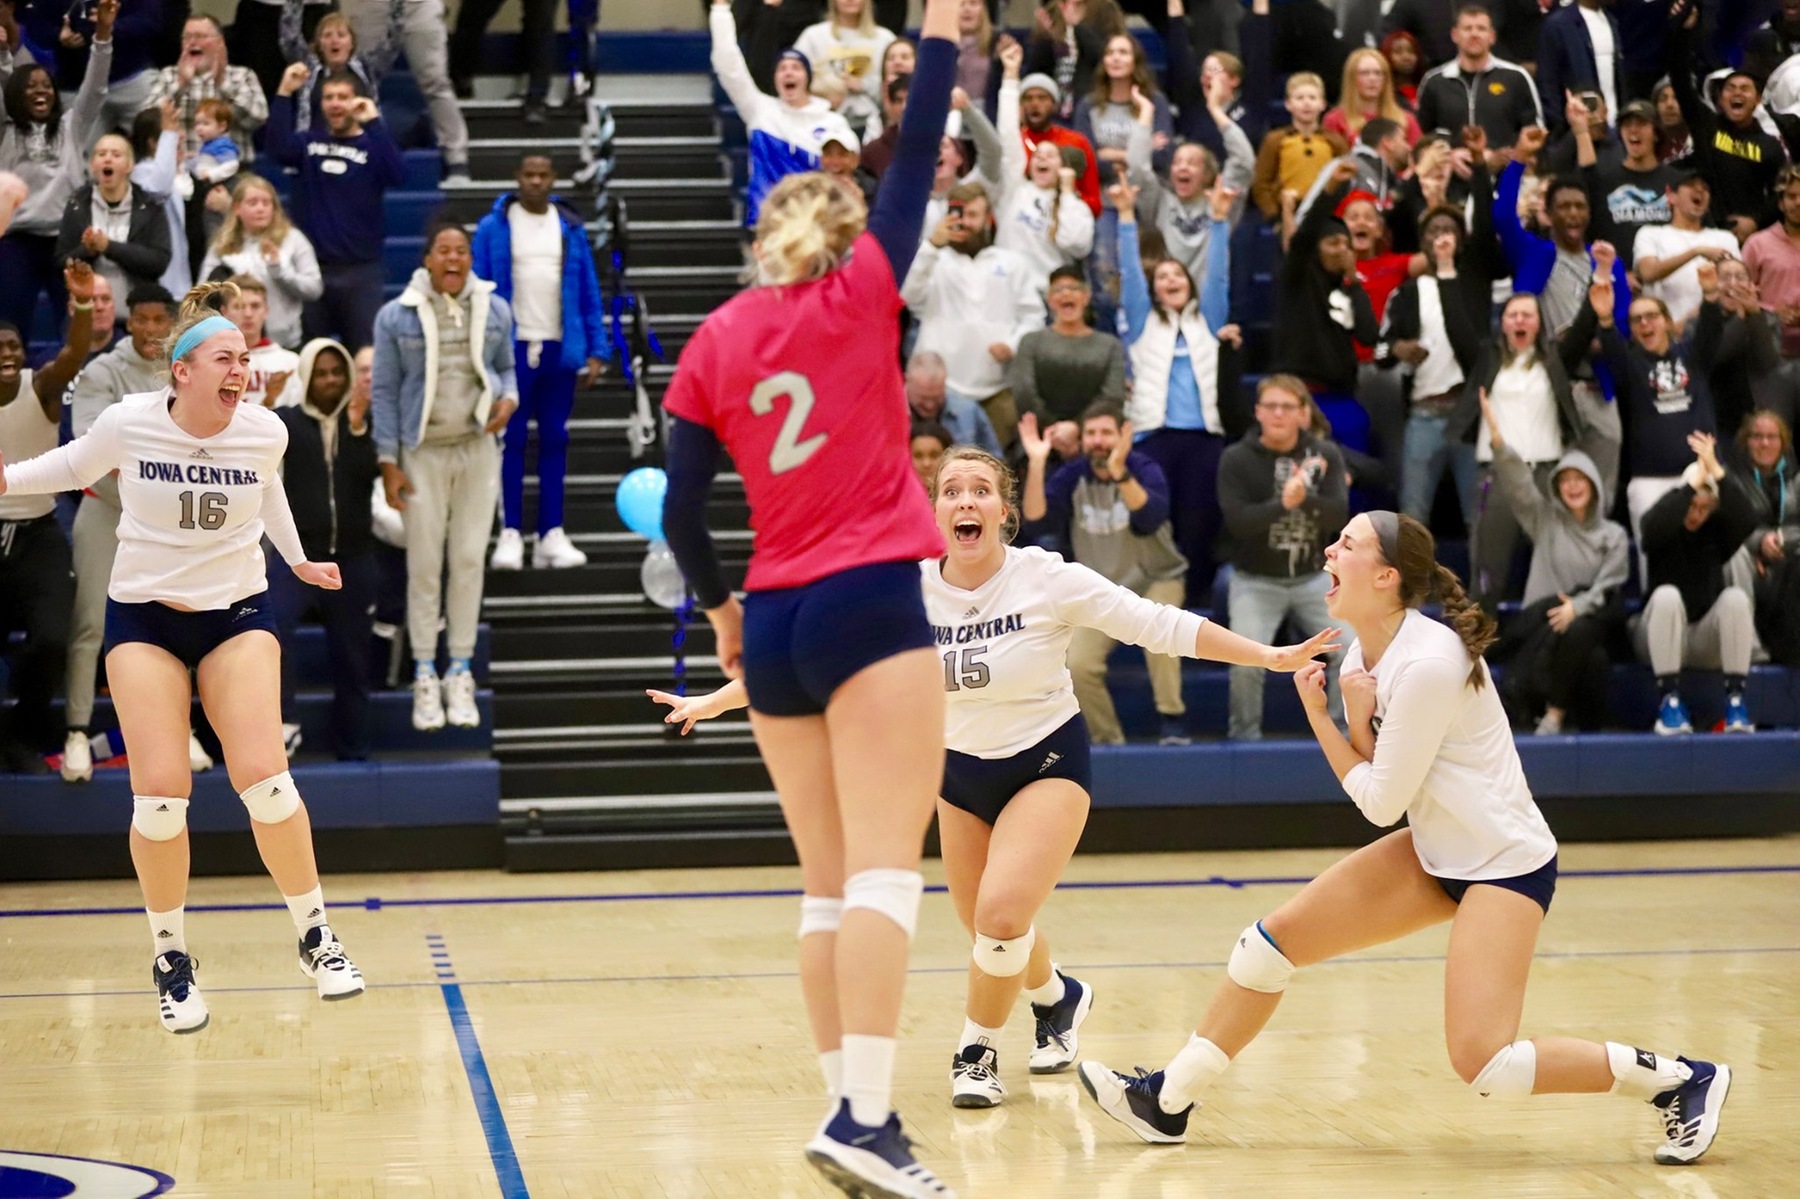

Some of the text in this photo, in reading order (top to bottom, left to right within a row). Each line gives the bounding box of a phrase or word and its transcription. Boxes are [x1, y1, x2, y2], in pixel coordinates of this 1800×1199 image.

[749, 370, 828, 476] 2
[138, 459, 185, 484] IOWA
[179, 490, 229, 530] 16
[932, 613, 1026, 645] WA CENTRAL
[943, 645, 990, 692] 15
